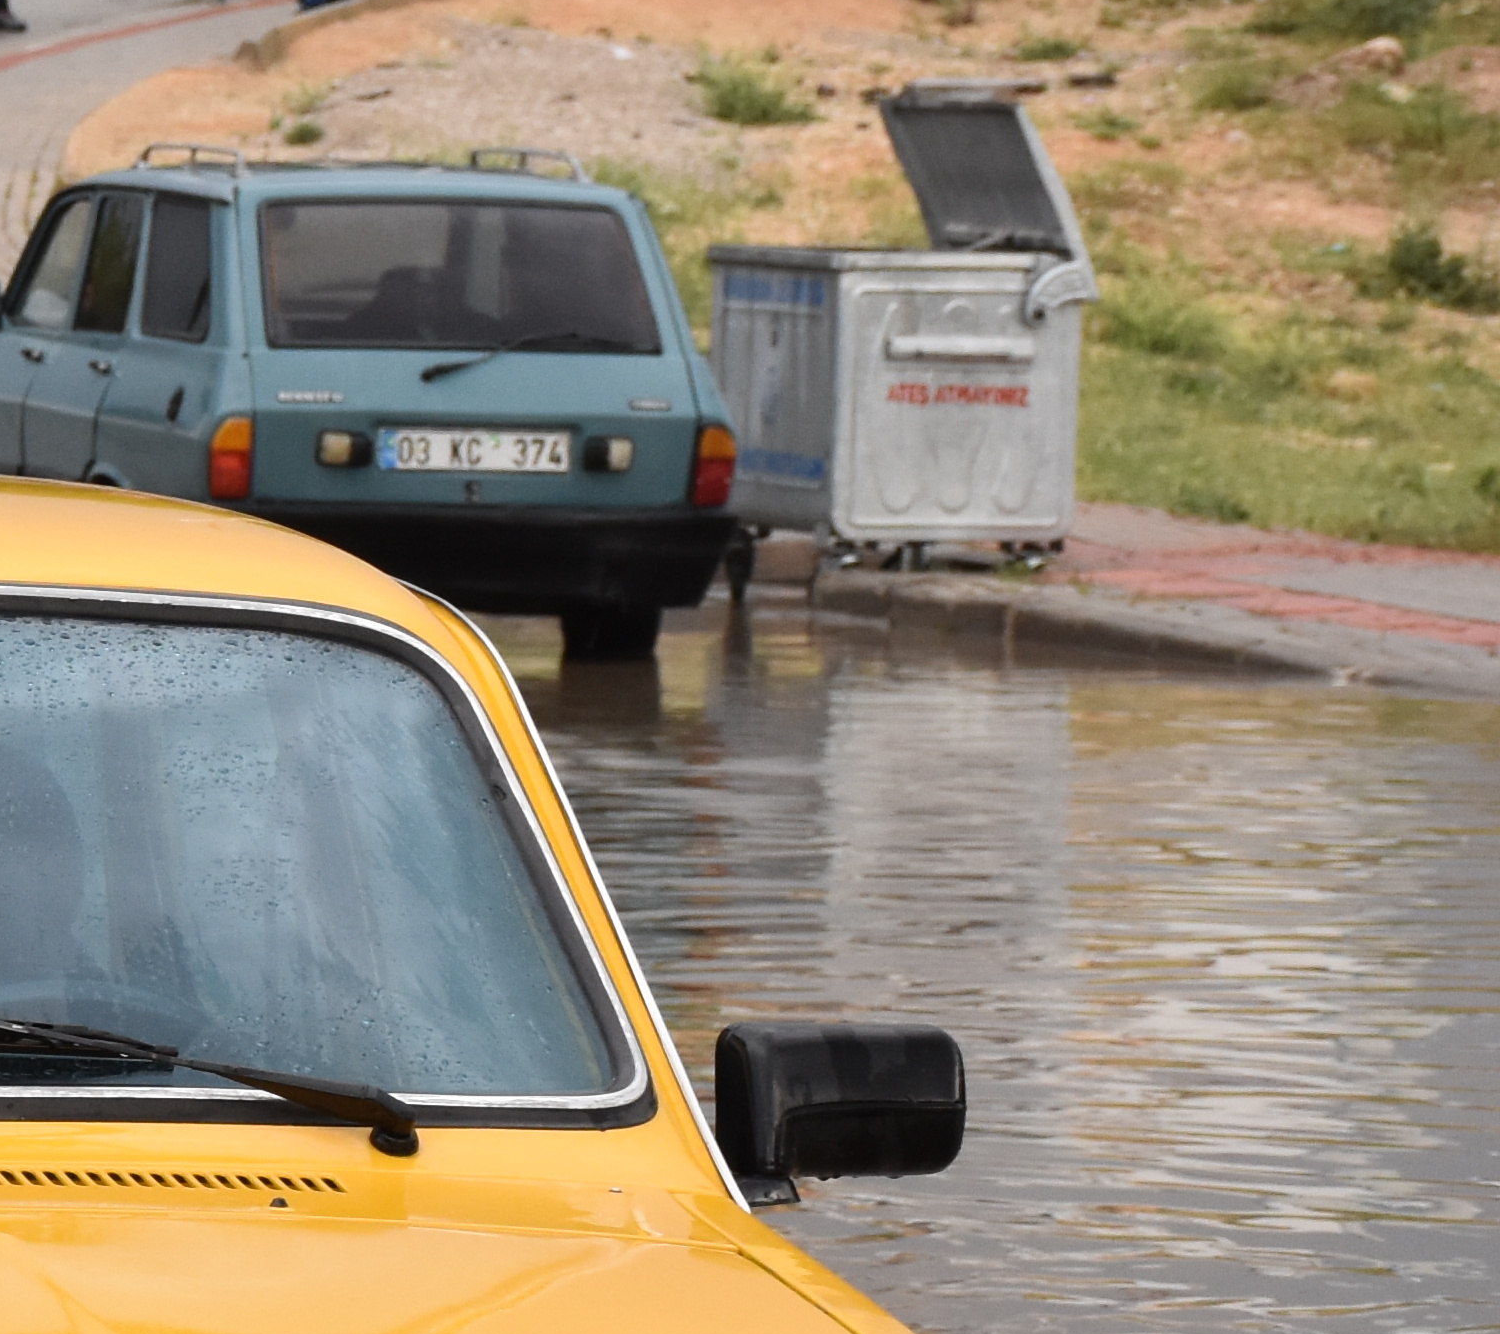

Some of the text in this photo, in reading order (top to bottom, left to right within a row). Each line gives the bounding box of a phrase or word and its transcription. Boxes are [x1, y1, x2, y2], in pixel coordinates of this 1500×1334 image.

[398, 436, 564, 467] 03 KC 374
